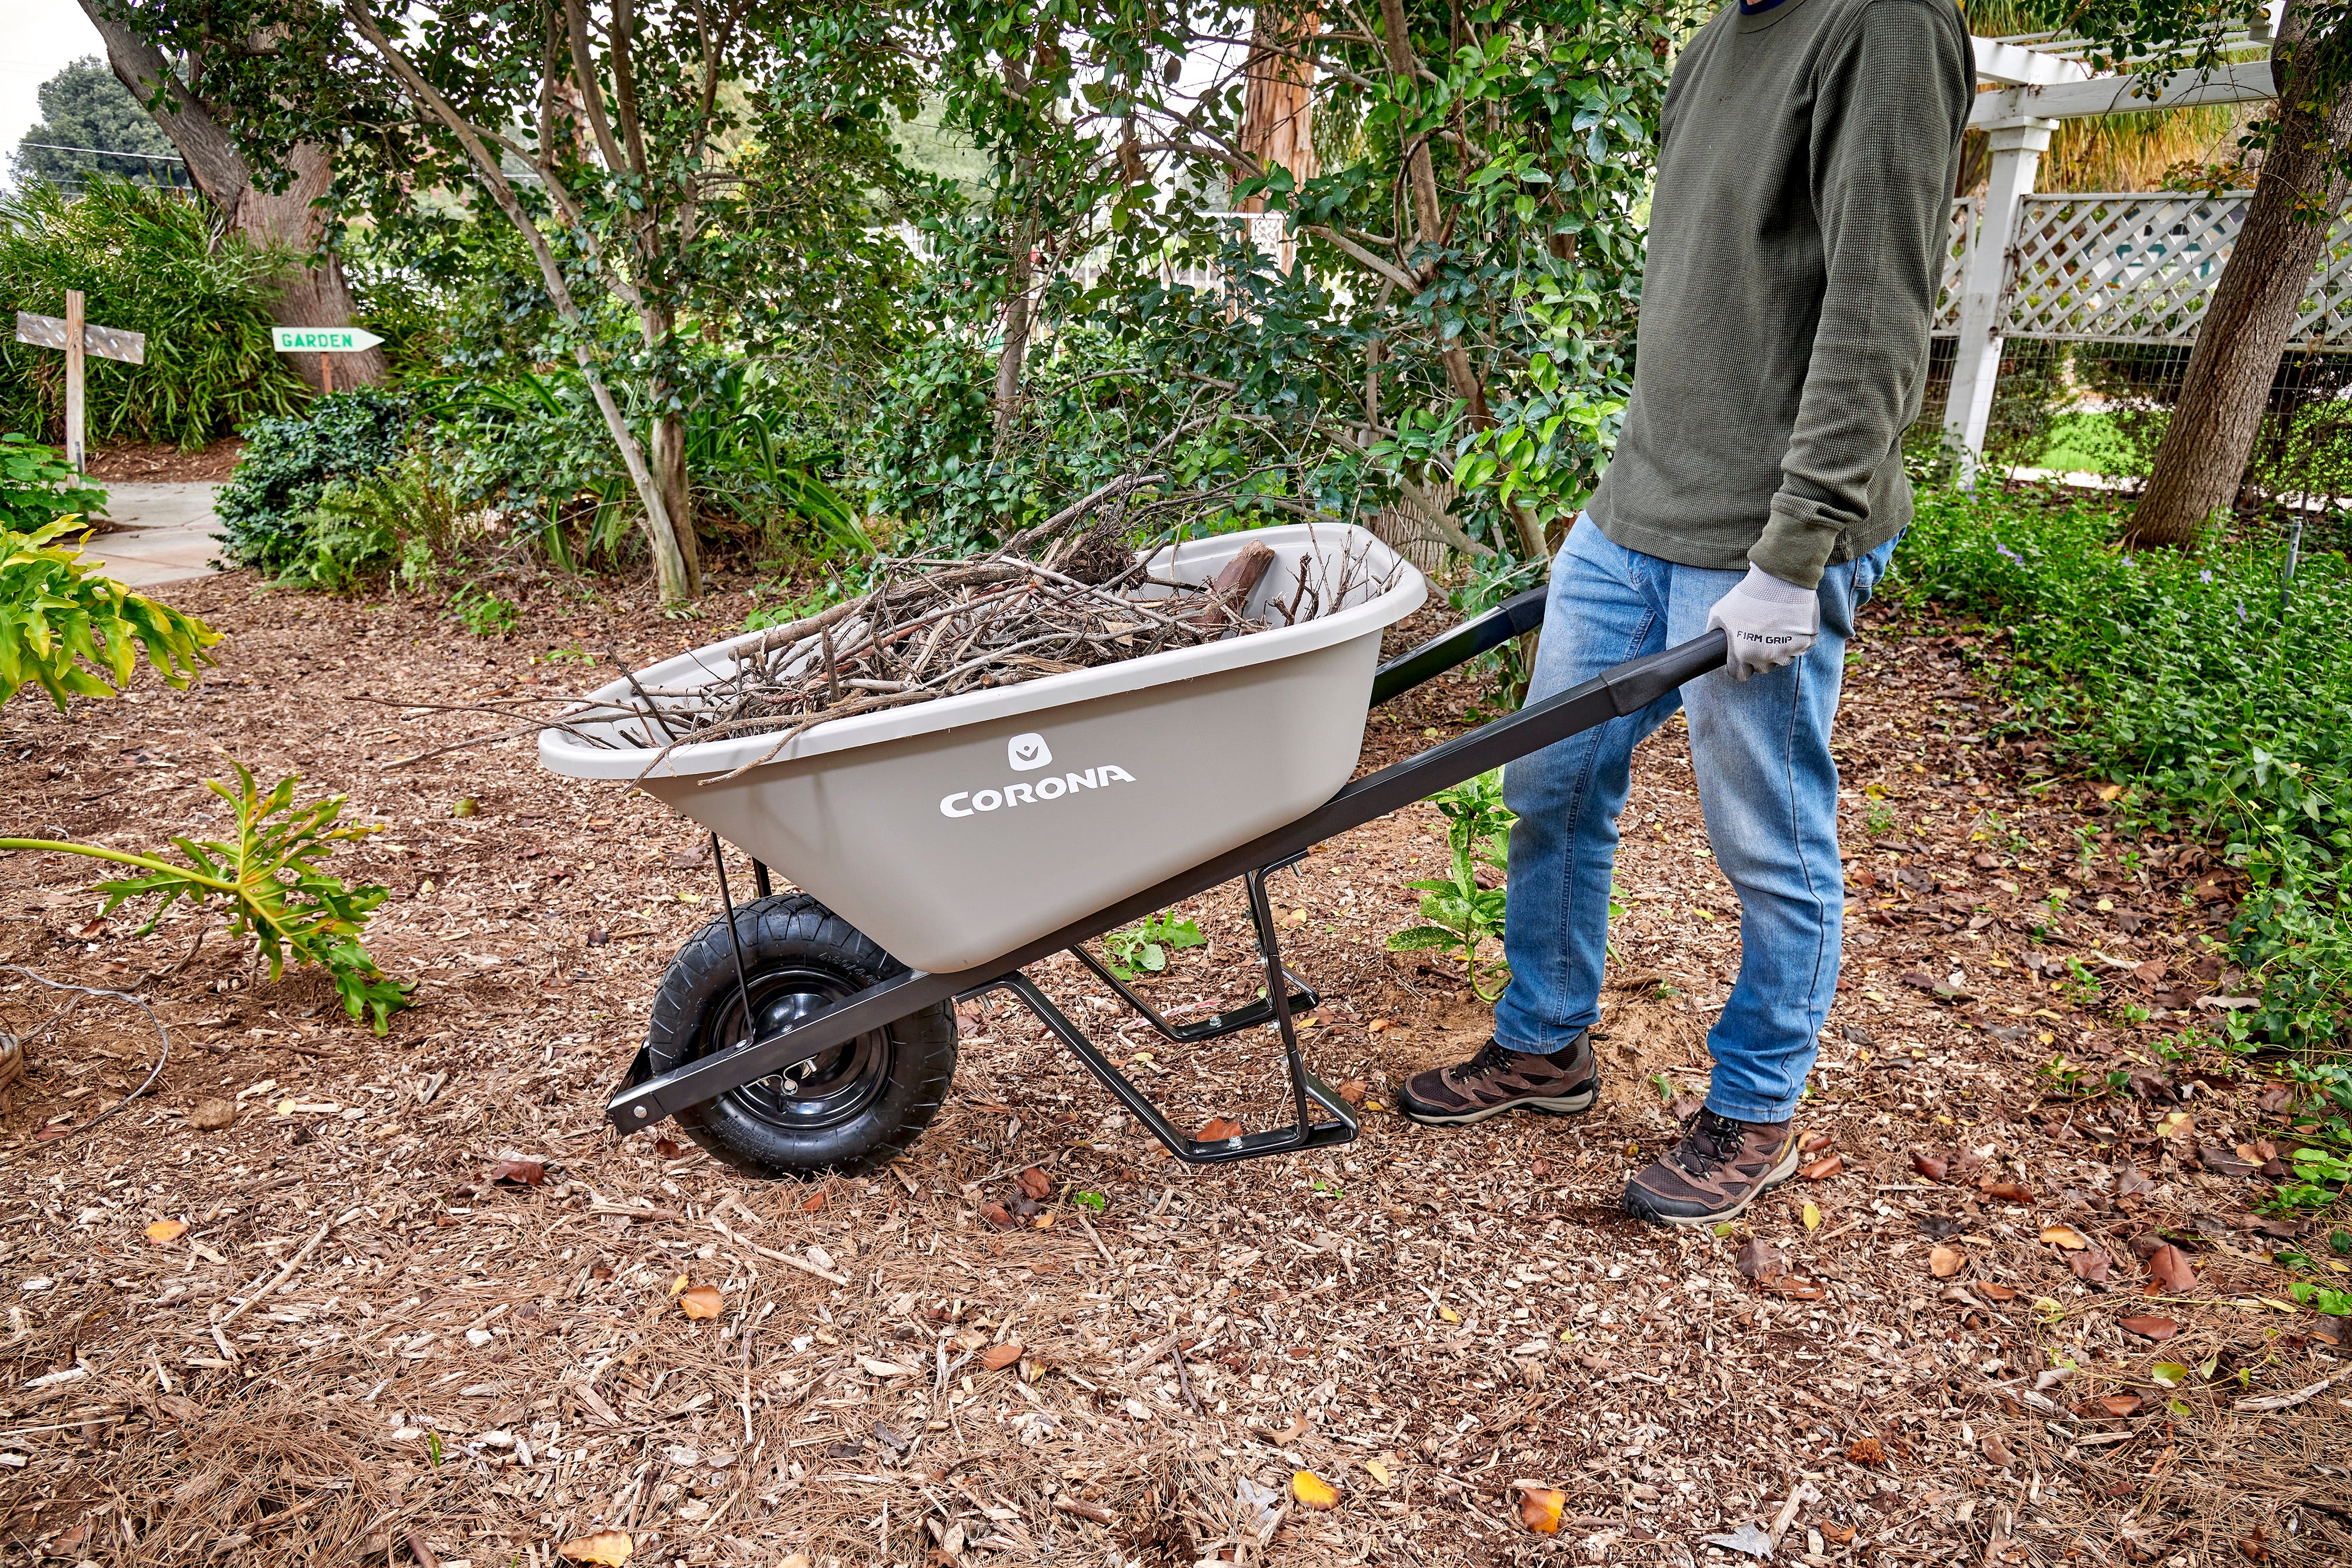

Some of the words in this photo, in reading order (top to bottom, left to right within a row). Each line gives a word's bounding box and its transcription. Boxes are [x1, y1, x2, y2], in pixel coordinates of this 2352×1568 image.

[281, 333, 353, 347] GARDEN
[1736, 630, 1763, 643] FIRM
[1765, 636, 1792, 644] GRIP
[939, 764, 1138, 818] CORONA
